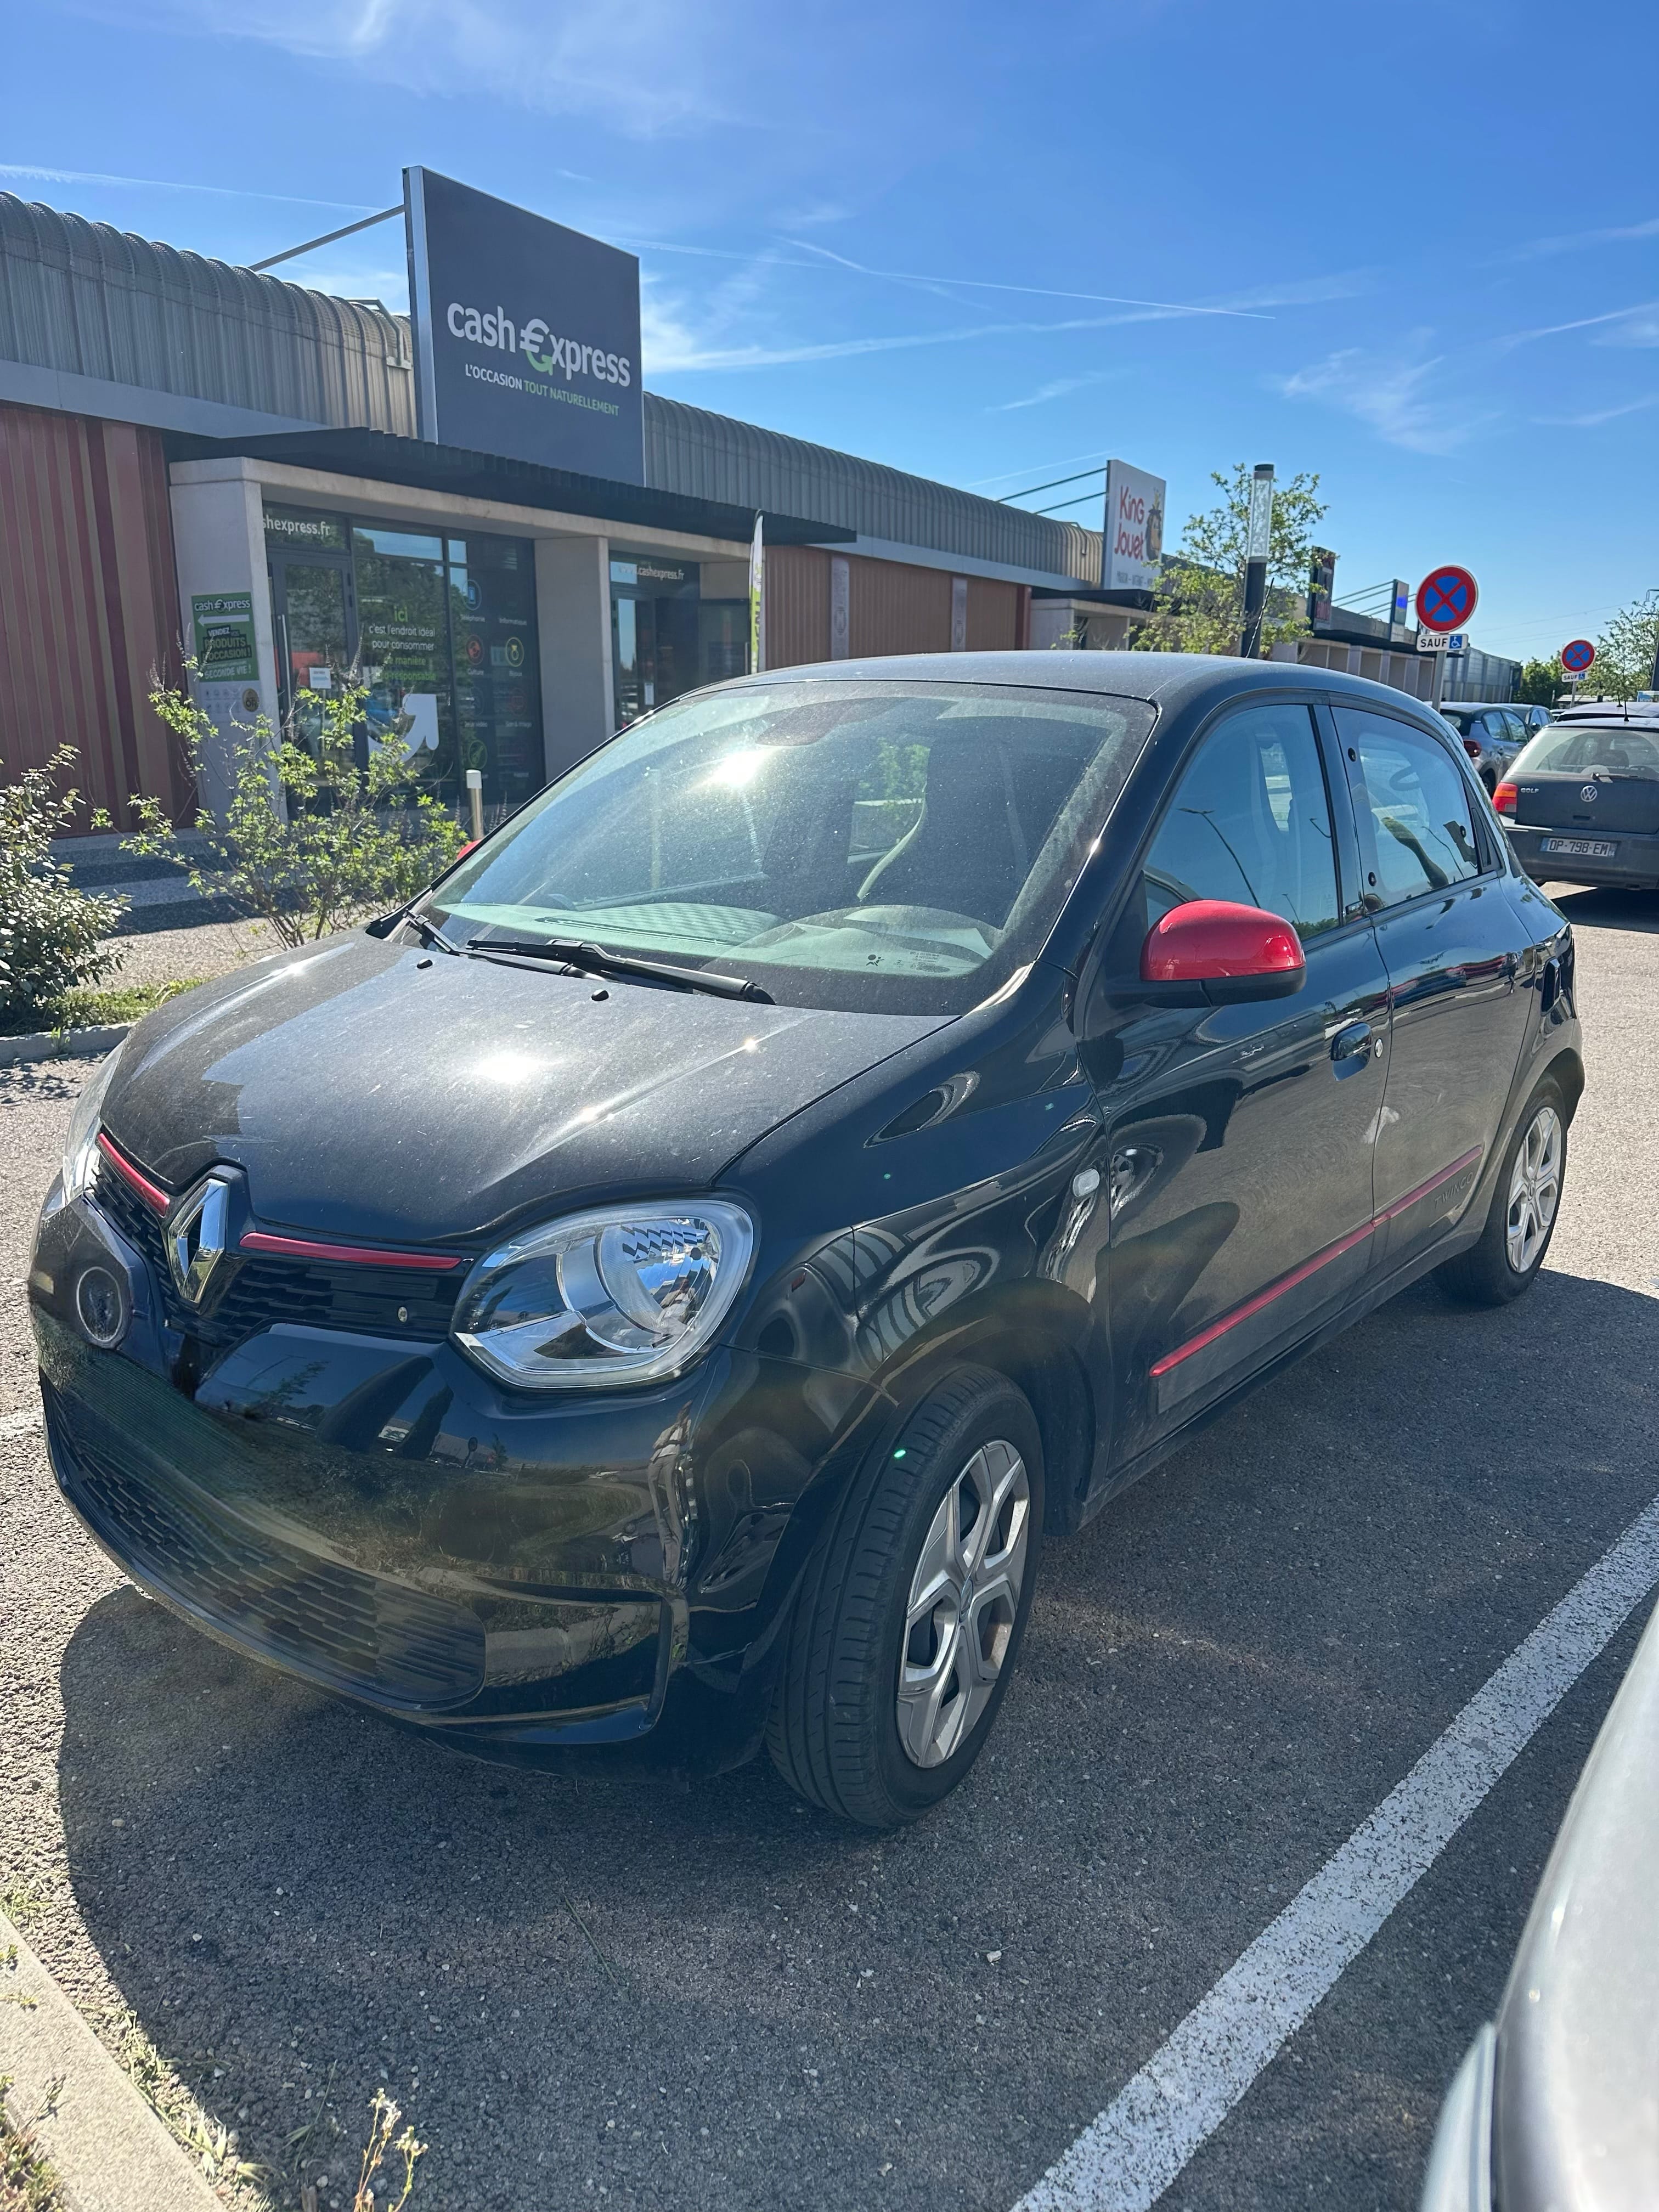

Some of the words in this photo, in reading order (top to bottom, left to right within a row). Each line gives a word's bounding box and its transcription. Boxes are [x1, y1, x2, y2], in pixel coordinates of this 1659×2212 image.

[447, 302, 516, 353] cash
[465, 363, 522, 391] L'OCCASION
[523, 380, 549, 397] TOUT
[550, 387, 619, 417] NATURELLEMENT
[1114, 522, 1144, 561] Jouet
[194, 600, 214, 612] cash
[393, 604, 409, 622] ici
[368, 623, 387, 634] c'est
[387, 624, 417, 636] l'endroit
[418, 627, 436, 637] idéal
[204, 636, 246, 650] PRODUITS
[372, 640, 390, 651] pour
[391, 641, 435, 651] consommer
[1420, 637, 1448, 648] SAUF
[394, 656, 427, 665] manière
[204, 666, 236, 679] SECONDE
[236, 665, 247, 675] VIE
[1434, 1171, 1474, 1210] TWINGO
